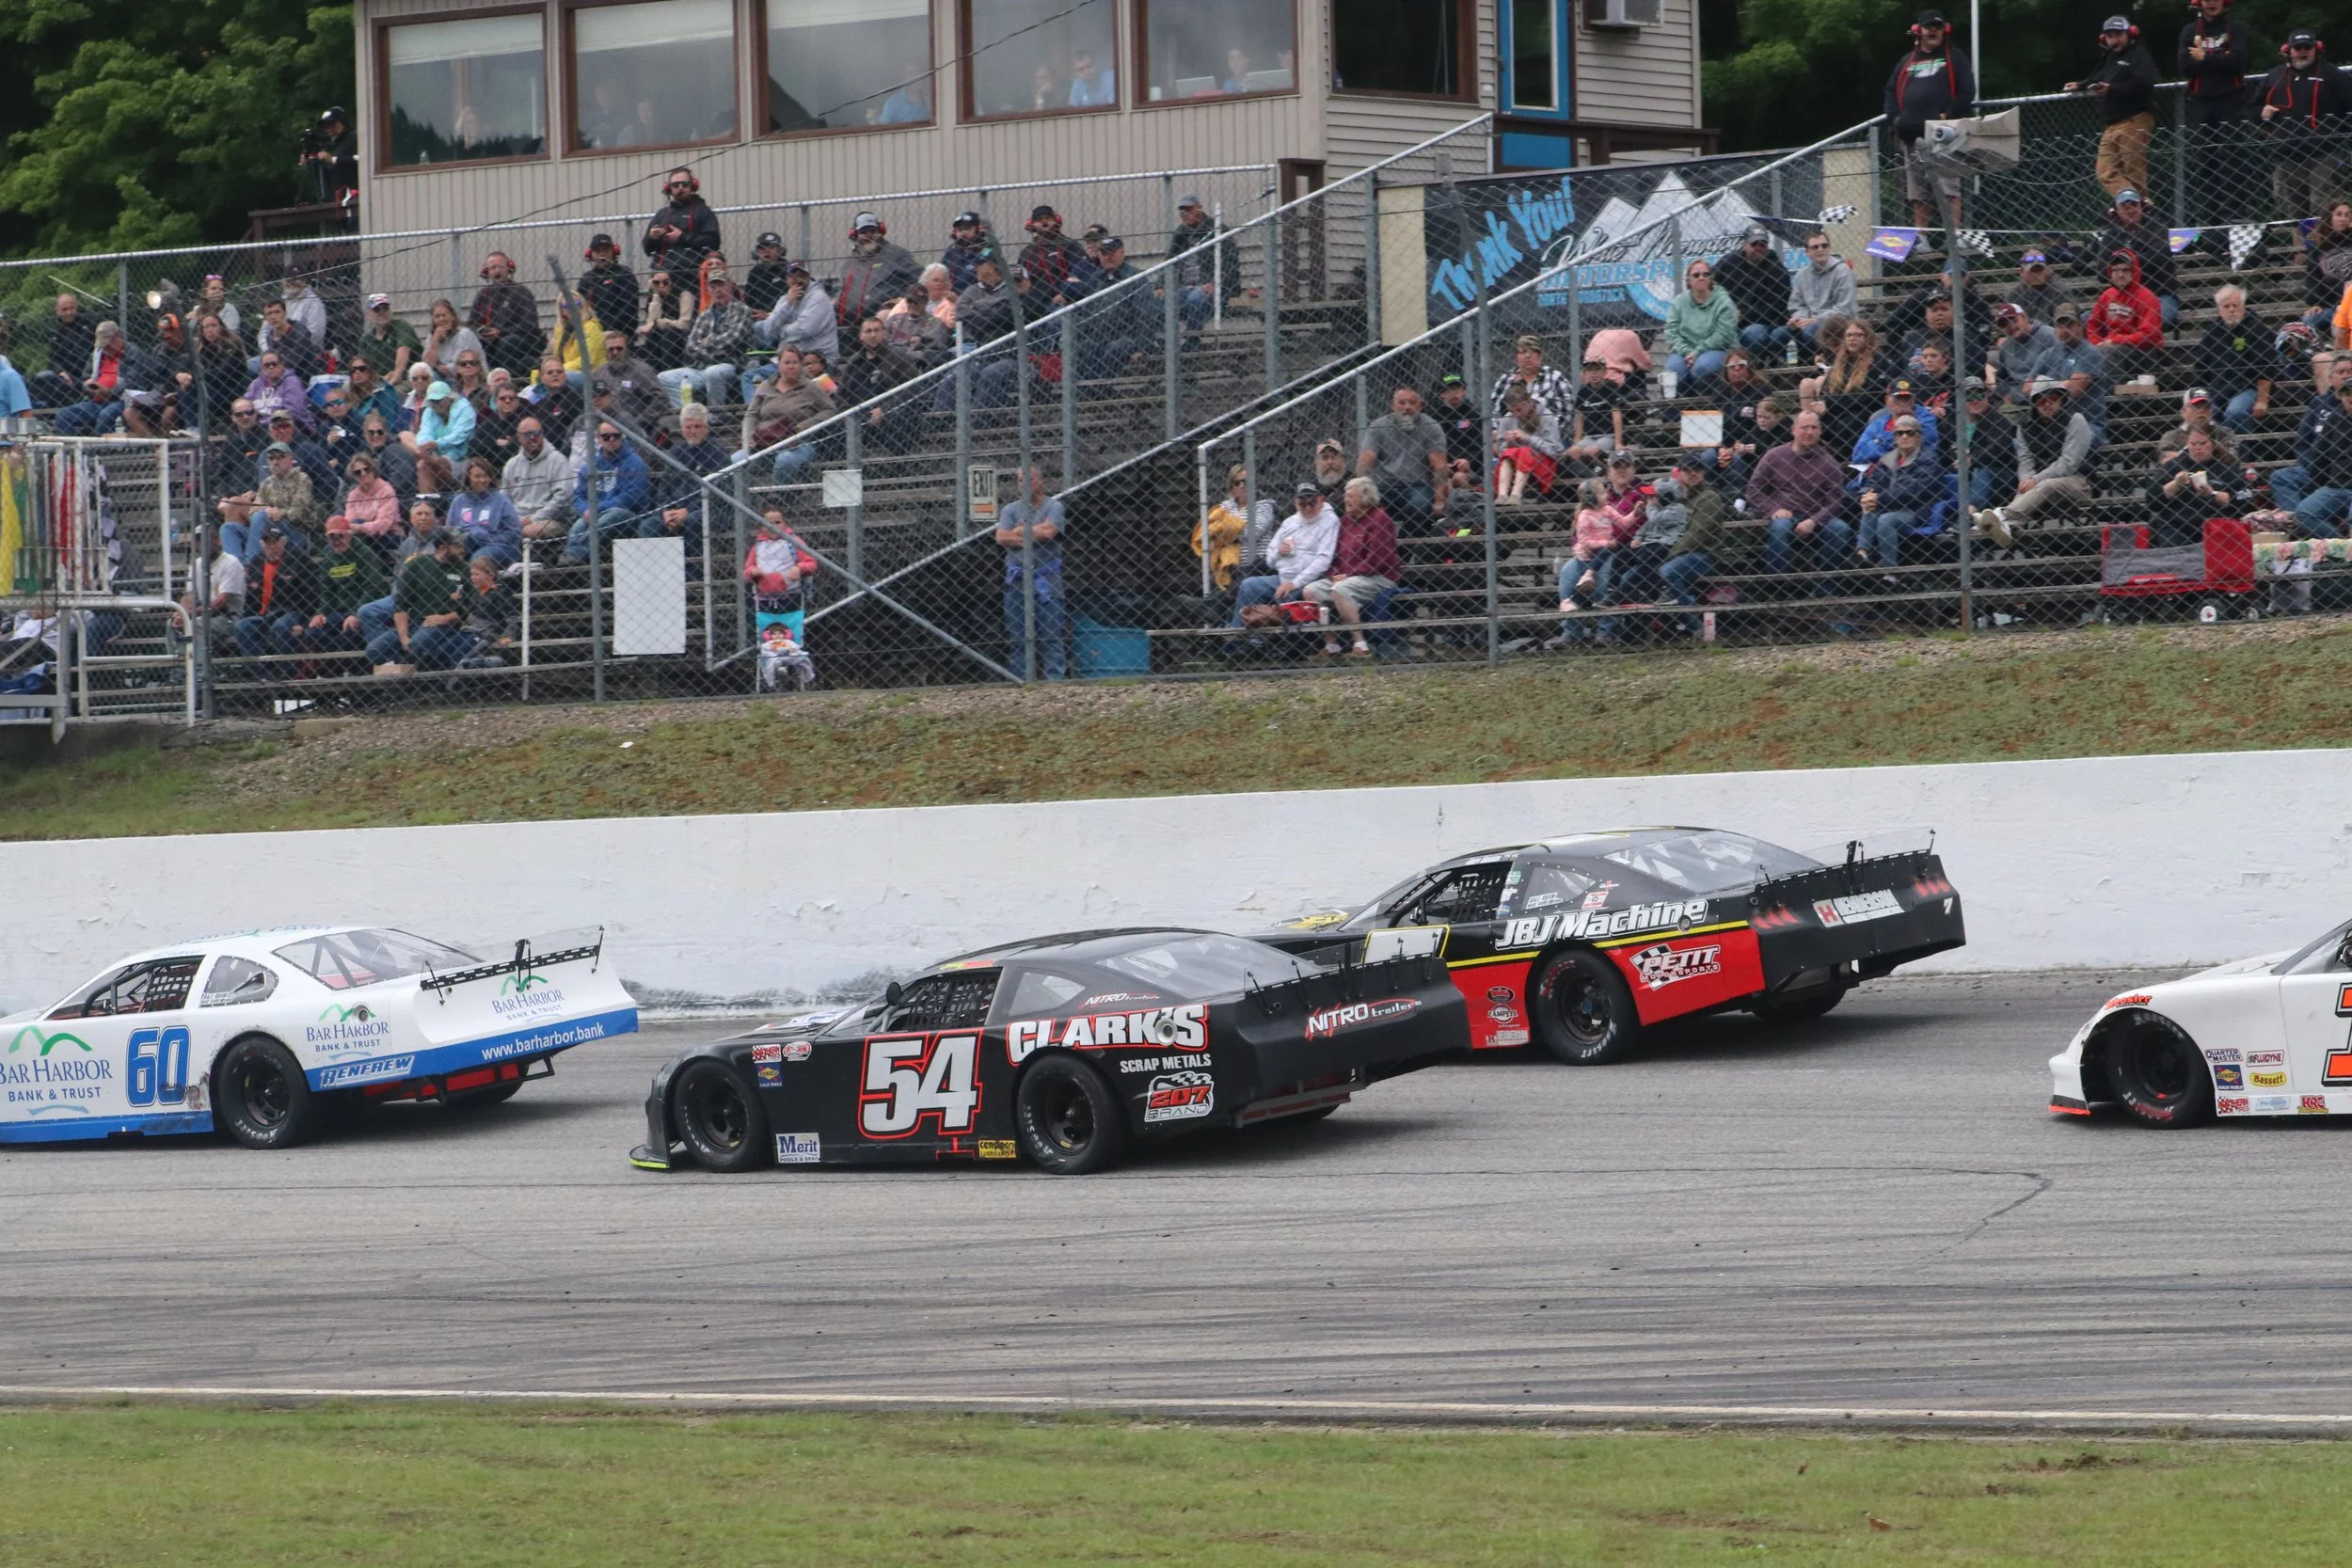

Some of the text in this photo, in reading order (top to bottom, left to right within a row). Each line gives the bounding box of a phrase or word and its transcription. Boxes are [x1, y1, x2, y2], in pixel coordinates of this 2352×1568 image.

[973, 469, 993, 498] EXIT
[1818, 904, 1839, 923] H
[1943, 896, 1953, 915] 7
[1495, 916, 1558, 950] JBJ
[1556, 899, 1708, 941] Machine
[1641, 946, 1719, 974] PETIT
[1640, 962, 1720, 982] MOTORSPORTS
[492, 990, 564, 1014] BAR HARBOR
[1084, 993, 1127, 1006] NITRO
[506, 1011, 528, 1022] BANK
[539, 1005, 563, 1014] TRUST
[1308, 1000, 1422, 1034] NITRO trailers
[307, 1022, 389, 1042] BAR HARBOR
[482, 1022, 604, 1061] www.barharbor.bank
[315, 1043, 340, 1053] BANK
[353, 1038, 381, 1049] TRUST
[2205, 1050, 2238, 1059] QUARTER
[33, 1059, 113, 1083] HARBOR
[125, 1024, 191, 1108] 60
[322, 1055, 414, 1085] RENFREW
[1120, 1053, 1212, 1073] SCRAP METALS
[861, 1035, 979, 1133] 54
[2253, 1074, 2283, 1085] Bassett
[8, 1086, 102, 1102] BANK & TRUST
[1150, 1085, 1211, 1109] 207
[2301, 1095, 2326, 1109] KRC
[1148, 1104, 1208, 1119] BRAND
[779, 1135, 818, 1153] Merit
